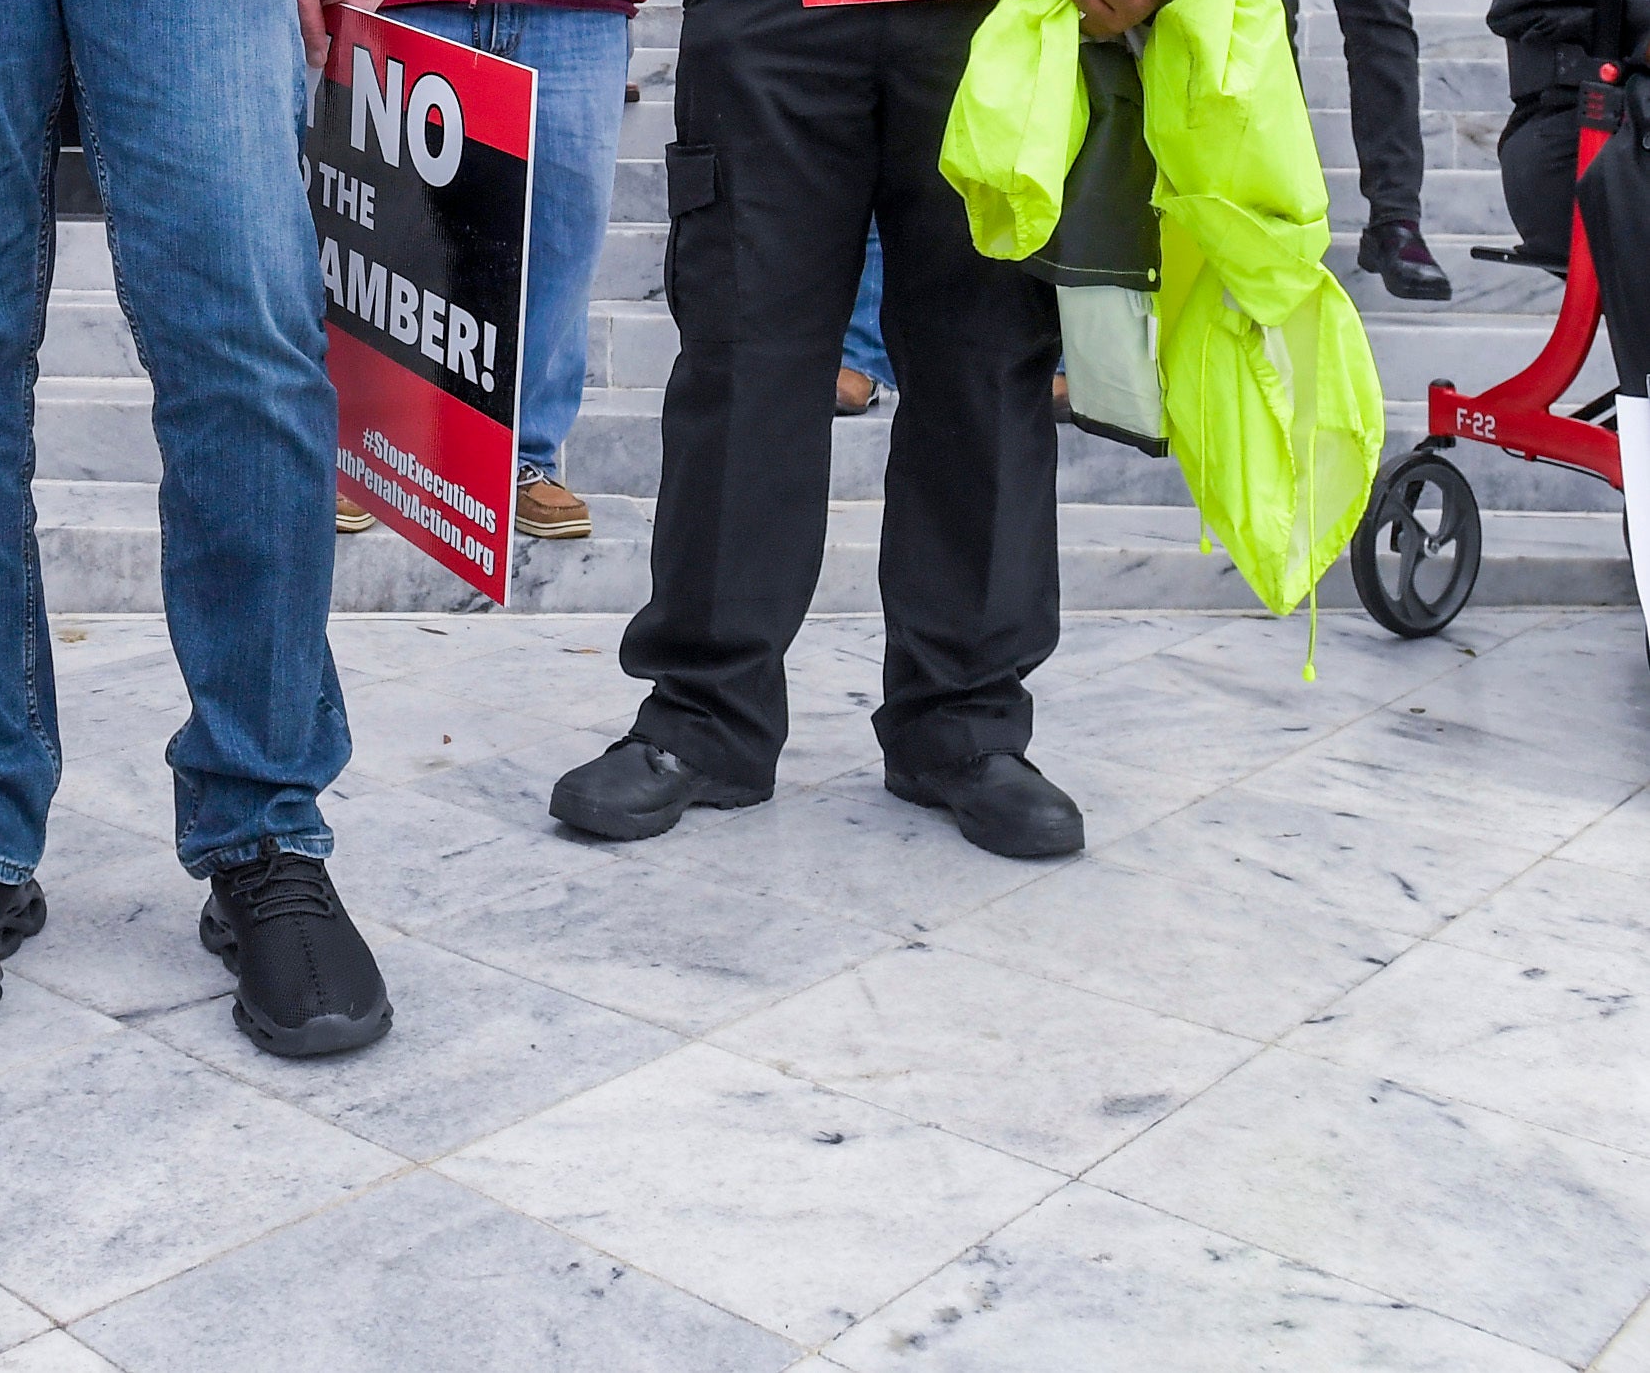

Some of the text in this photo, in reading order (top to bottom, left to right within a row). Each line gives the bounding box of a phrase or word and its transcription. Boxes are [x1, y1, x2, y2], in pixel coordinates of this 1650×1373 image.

[351, 44, 463, 186] NO
[319, 161, 375, 231] THE
[320, 236, 497, 393] AMBER!
[362, 428, 496, 534] #StopExecutions
[1456, 407, 1497, 440] F-22
[336, 447, 495, 575] thPenaltyAction.org
